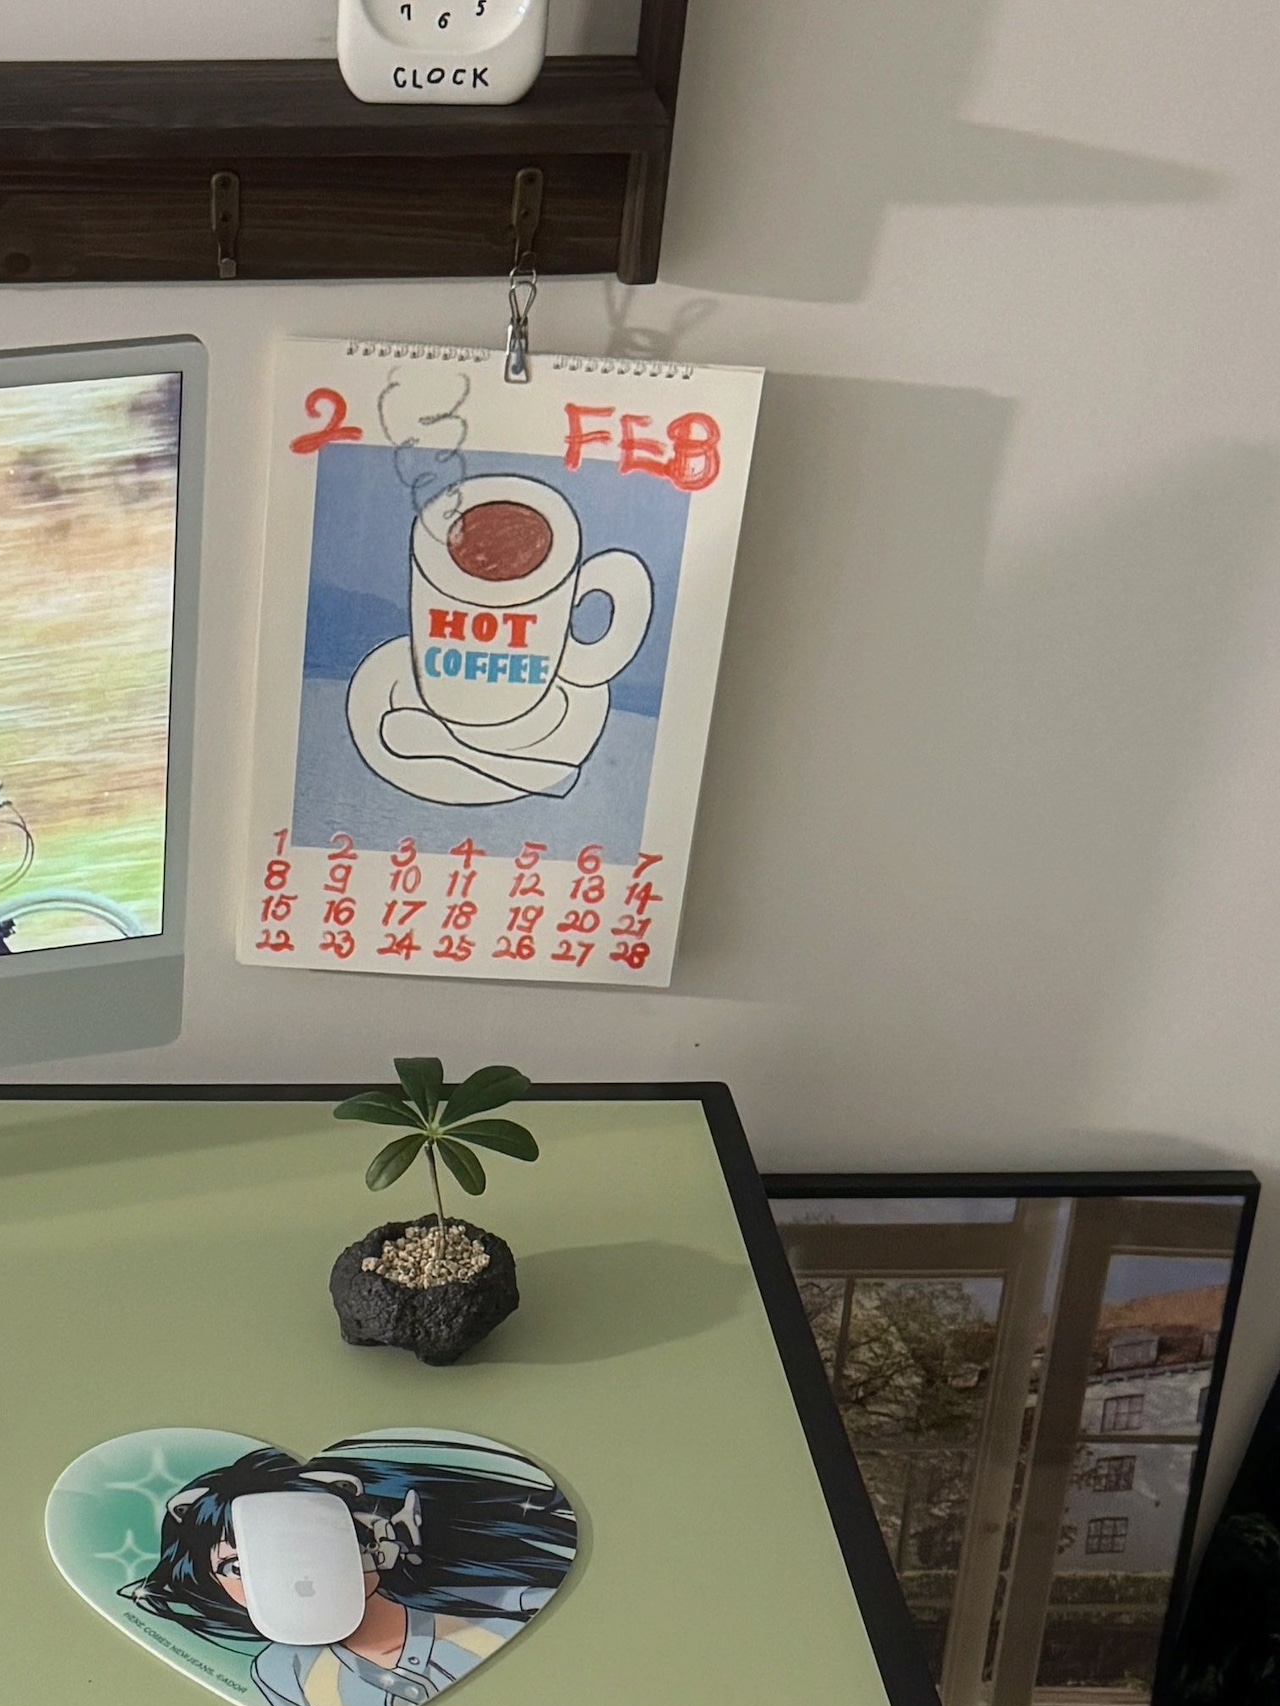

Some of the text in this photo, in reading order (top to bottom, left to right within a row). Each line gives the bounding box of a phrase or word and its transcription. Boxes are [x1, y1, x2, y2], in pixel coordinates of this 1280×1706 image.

[400, 3, 412, 21] 7
[437, 12, 451, 29] 6
[475, 0, 488, 17] 5
[393, 66, 489, 89] CLOCK
[289, 386, 364, 456] 2
[564, 402, 723, 493] FEB
[427, 609, 538, 650] HOT
[424, 647, 548, 686] COFFEE
[271, 828, 663, 880] 1 2 3 4 5 6 7
[263, 859, 664, 917] 8 9 10 11 12 13 14
[261, 894, 652, 942] 15 16 17 18 19 20 21
[255, 929, 652, 971] 22 23 24 25 26 27 28
